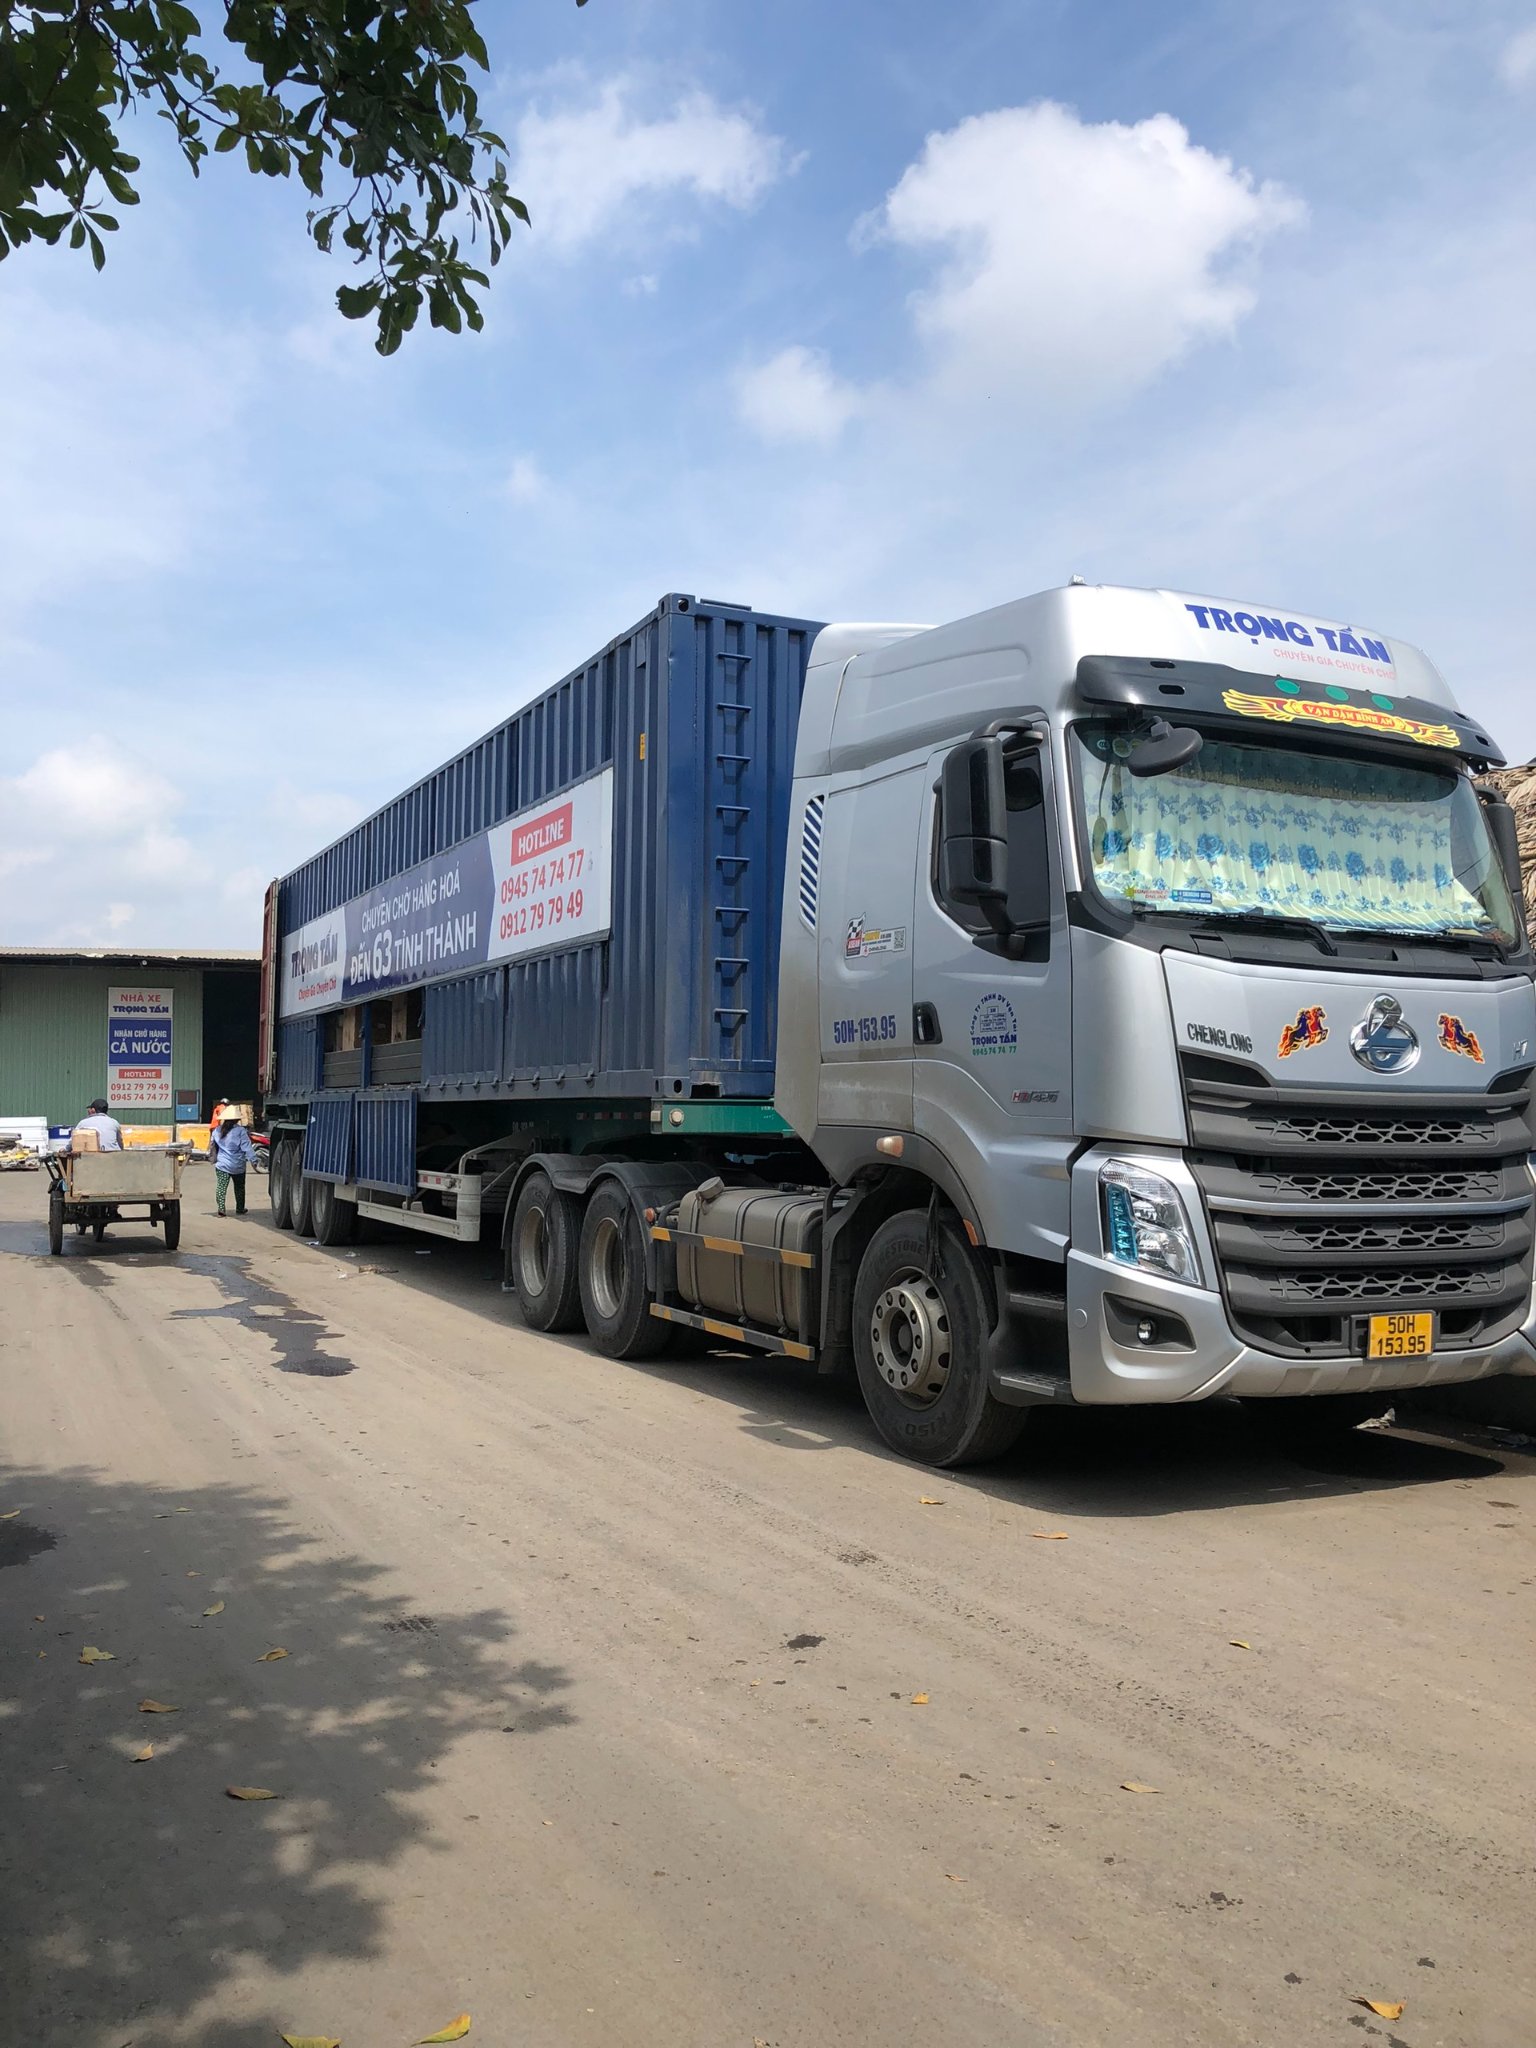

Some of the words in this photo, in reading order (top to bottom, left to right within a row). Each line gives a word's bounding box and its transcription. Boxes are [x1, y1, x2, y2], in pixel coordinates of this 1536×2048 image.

[1184, 604, 1314, 645] TRỌNG
[1315, 626, 1392, 664] TẤN
[1273, 648, 1315, 664] CHUYÊN
[1317, 656, 1335, 667] GIA
[1335, 658, 1375, 676] CHUYÊN
[1306, 705, 1331, 717] VẠN
[1380, 717, 1394, 727] AN
[518, 818, 564, 857] HOTLINE
[501, 872, 529, 904] 0945
[532, 864, 546, 894] 74
[550, 857, 564, 887] 74
[569, 848, 584, 880] 77
[362, 897, 390, 933] CHUYÊN
[392, 886, 412, 920] CHỞ
[412, 879, 437, 912] HÀNG
[440, 861, 460, 900] HOÁ
[500, 908, 526, 940] 0912
[530, 902, 544, 931] 79
[548, 895, 563, 925] 79
[567, 889, 583, 919] 49
[350, 942, 371, 986] ĐẾN
[373, 929, 392, 979] 63
[395, 929, 423, 972] TỈNH
[426, 911, 477, 962] THÀNH
[292, 942, 318, 982] TRỌNG
[120, 991, 144, 1002] NHÀ
[147, 994, 161, 1002] XE
[113, 1005, 147, 1014] TRỌNG
[834, 1014, 896, 1044] 50H-153.95
[972, 1035, 998, 1047] TRỌNG
[1187, 1023, 1253, 1053] CHENGLONG
[111, 1038, 128, 1053] CẢ
[131, 1038, 170, 1054] NƯỚC
[972, 1048, 988, 1056] 0945
[989, 1047, 996, 1055] 74
[997, 1046, 1006, 1054] 74
[1009, 1045, 1017, 1053] 77
[1513, 1039, 1528, 1061] H7
[111, 1093, 131, 1101] 0945
[134, 1093, 144, 1101] 74
[147, 1093, 156, 1101] 74
[159, 1093, 169, 1101] 77
[1388, 1315, 1415, 1334] 50H
[1377, 1335, 1426, 1355] 153.95
